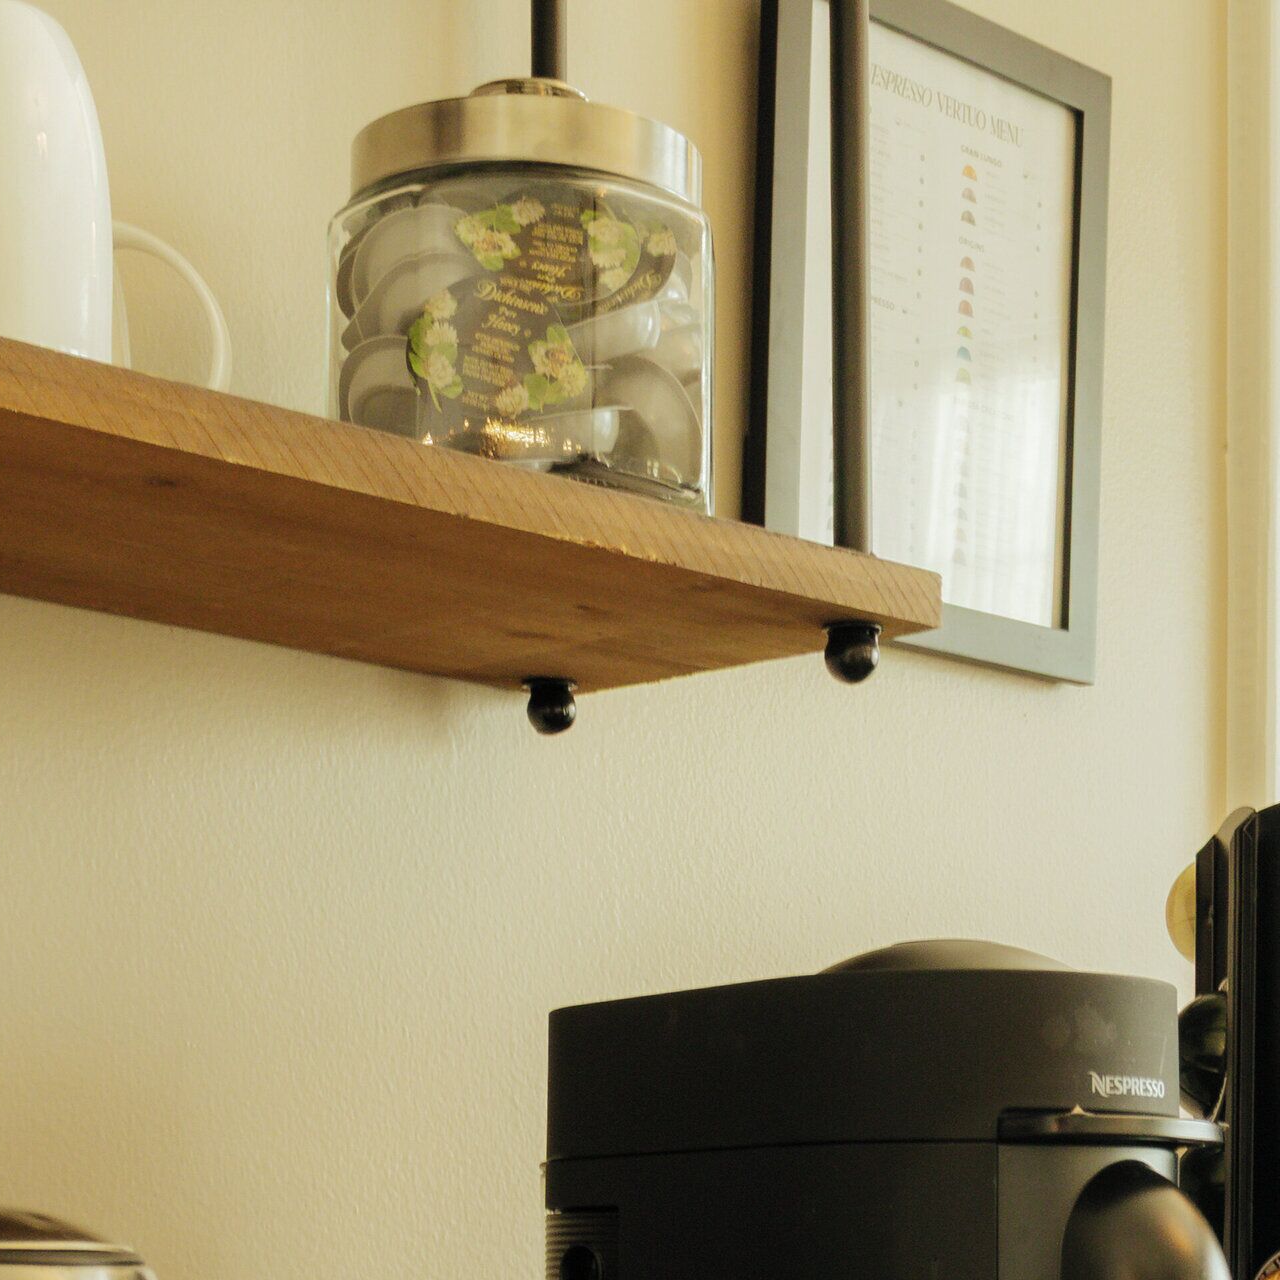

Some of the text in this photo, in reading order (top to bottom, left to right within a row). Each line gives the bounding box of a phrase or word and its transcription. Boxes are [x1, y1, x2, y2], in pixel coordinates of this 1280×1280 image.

[871, 63, 1025, 148] ESPRESSO VERTUO MENU
[1088, 1071, 1165, 1098] NESPRESSO
